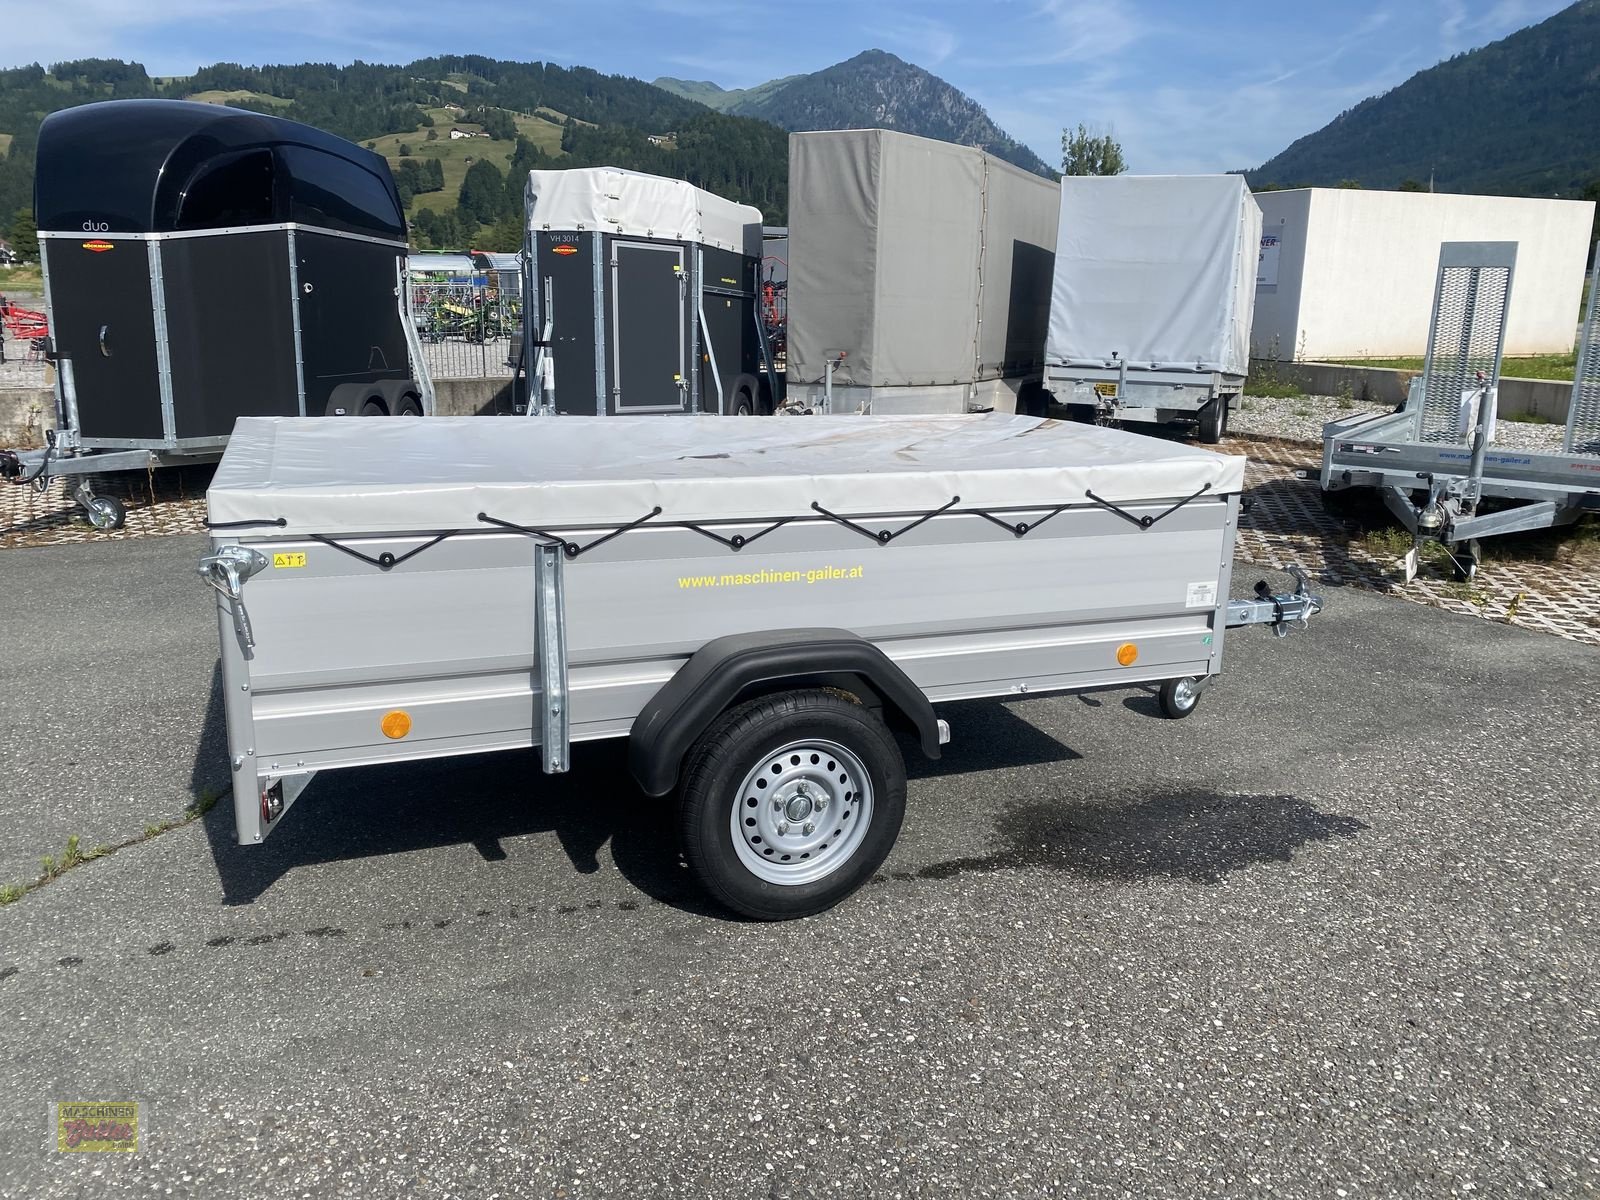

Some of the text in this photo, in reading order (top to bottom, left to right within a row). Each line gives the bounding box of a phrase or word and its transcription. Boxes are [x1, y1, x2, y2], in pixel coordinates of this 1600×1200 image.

[82, 219, 109, 231] duo
[1439, 453, 1531, 464] www.manen-gailer.at
[678, 565, 864, 588] www.maschinen-gailer.at
